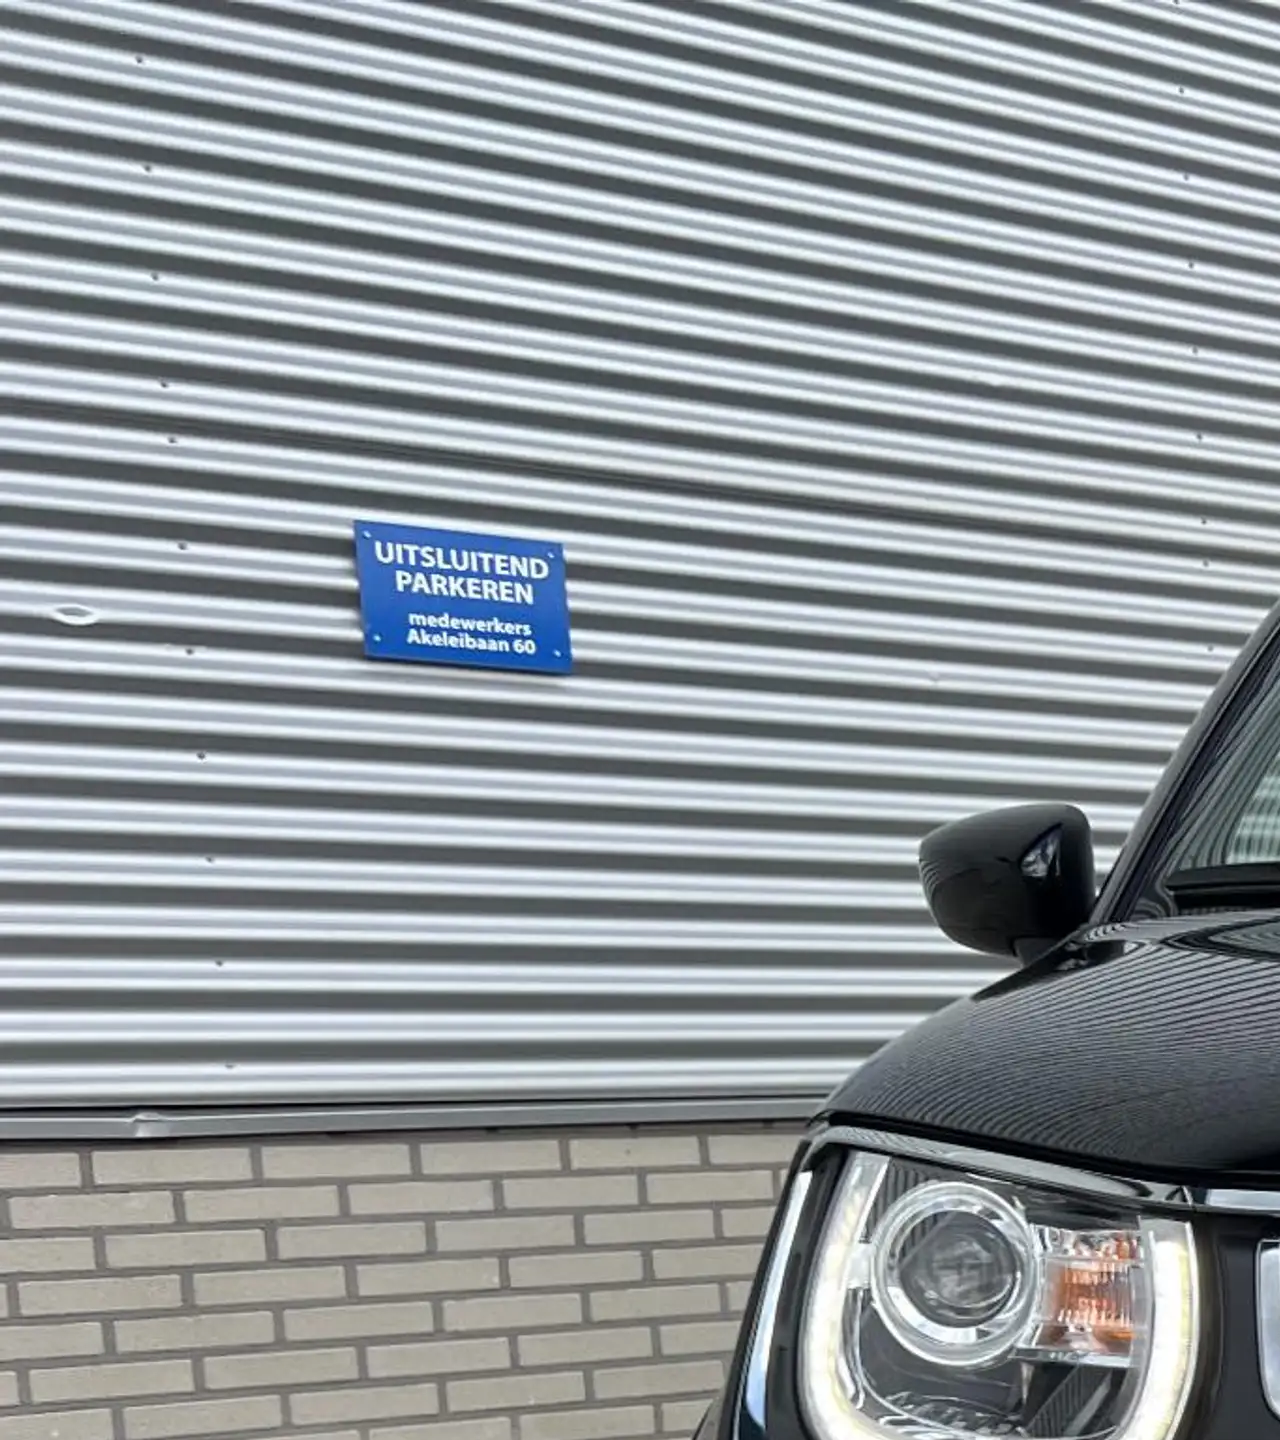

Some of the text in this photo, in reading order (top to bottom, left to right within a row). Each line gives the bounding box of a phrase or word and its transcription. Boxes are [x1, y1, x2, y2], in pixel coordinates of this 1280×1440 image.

[374, 540, 549, 579] UITSLUITEND
[396, 570, 533, 605] PARKEREN
[408, 612, 532, 636] medewerkers
[407, 630, 537, 655] Akeleibaan 60
